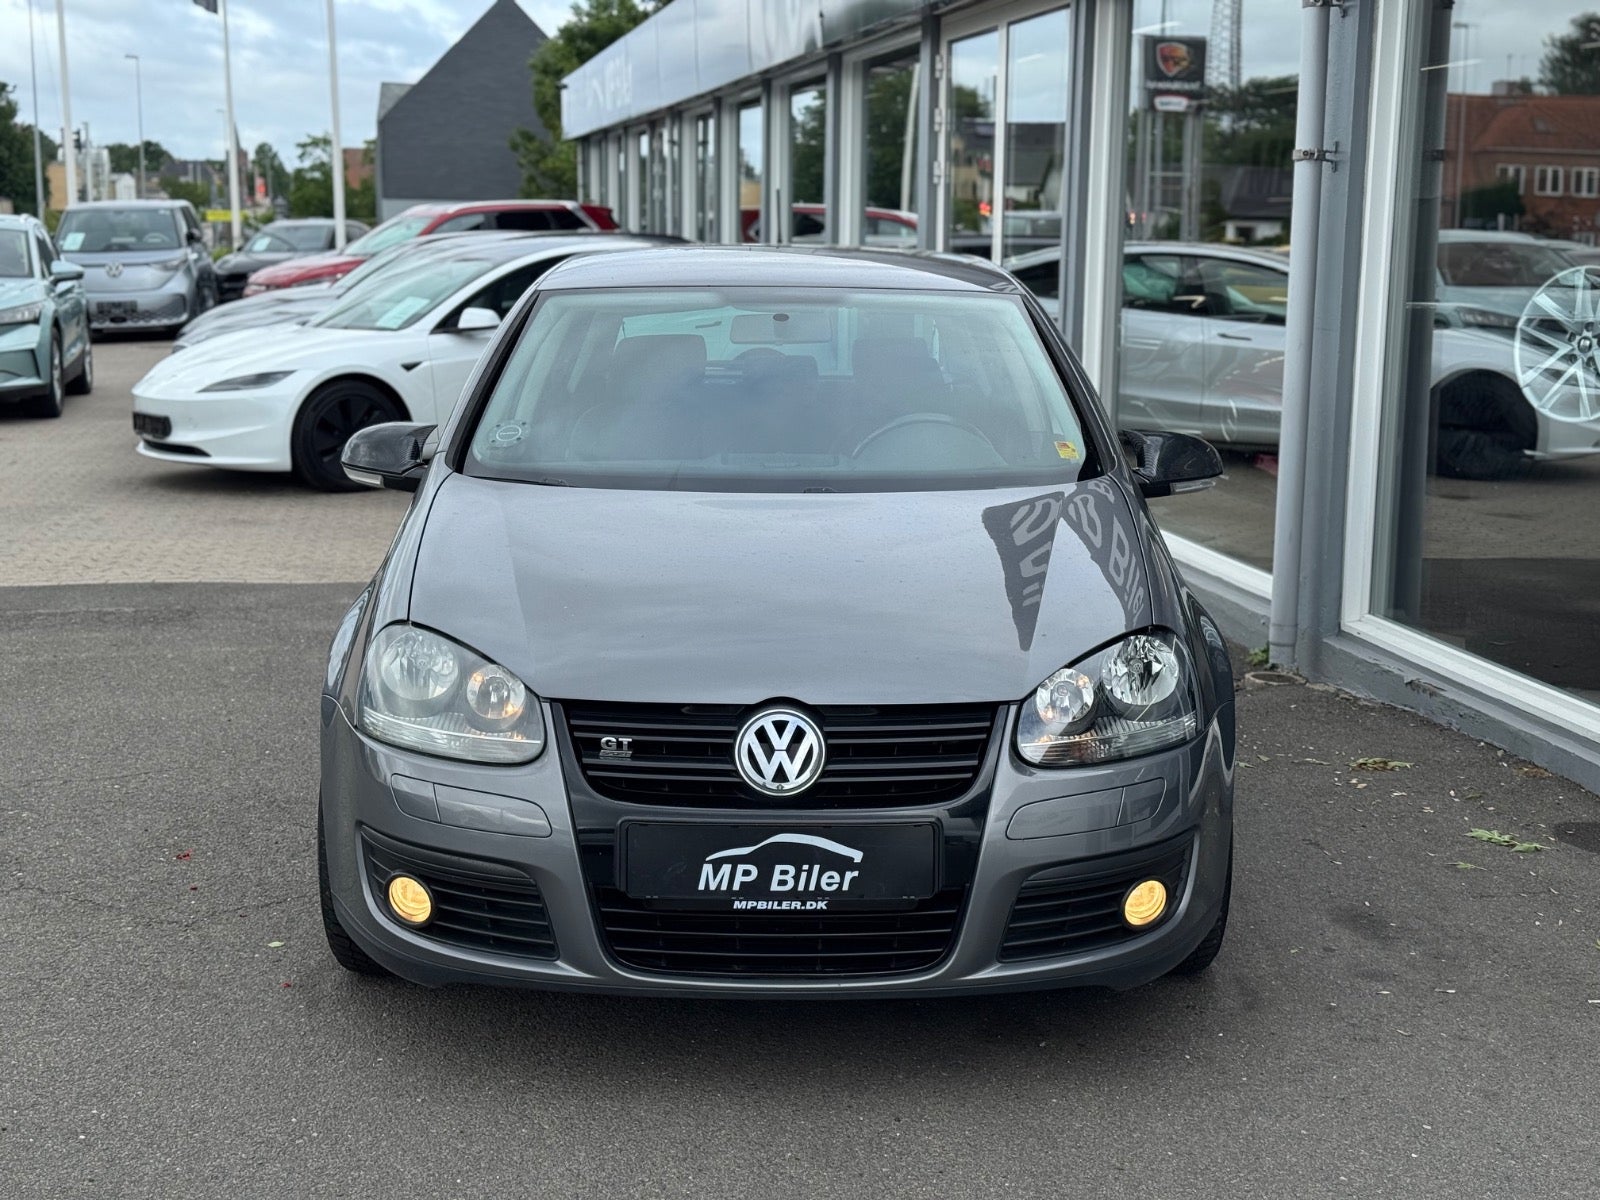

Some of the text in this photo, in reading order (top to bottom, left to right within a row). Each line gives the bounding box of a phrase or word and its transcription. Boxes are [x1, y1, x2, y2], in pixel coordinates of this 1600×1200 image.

[600, 736, 633, 750] GT
[739, 711, 822, 792] VW
[698, 863, 859, 892] MP Biler
[733, 900, 828, 910] MPBILER.DK
